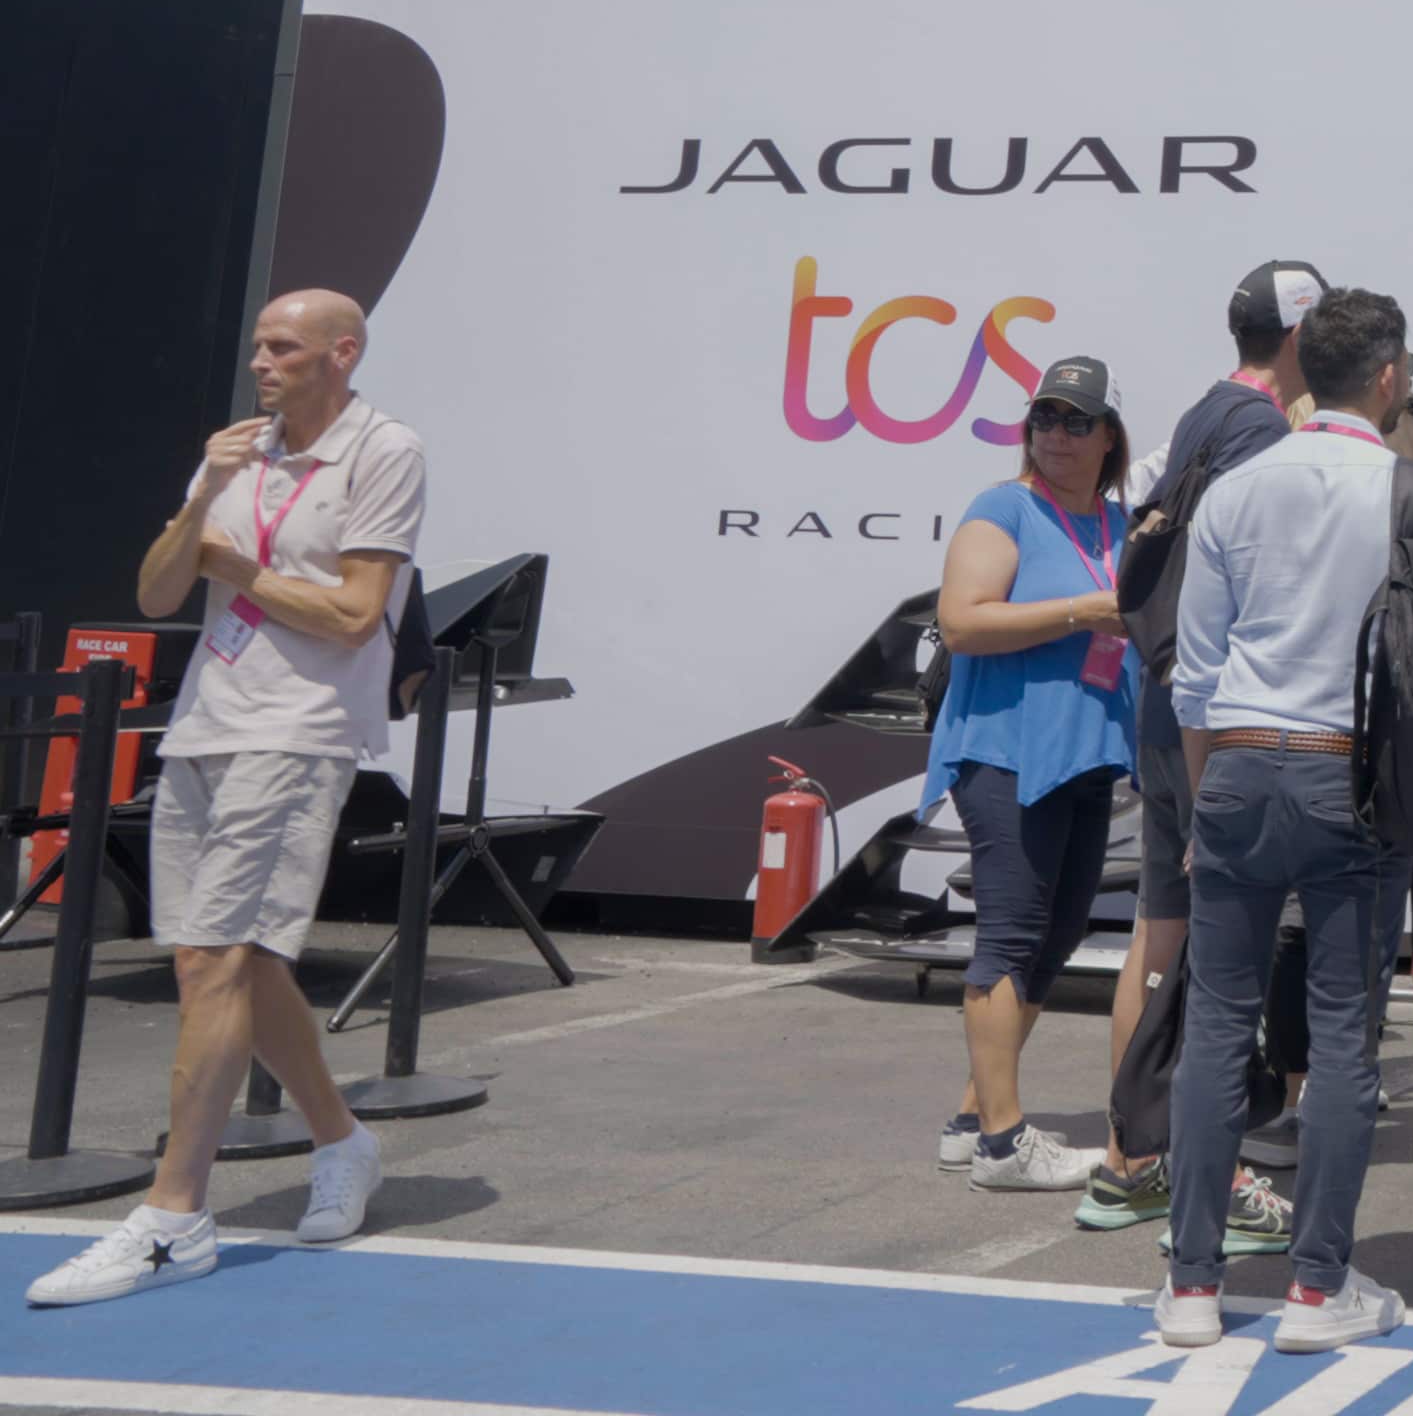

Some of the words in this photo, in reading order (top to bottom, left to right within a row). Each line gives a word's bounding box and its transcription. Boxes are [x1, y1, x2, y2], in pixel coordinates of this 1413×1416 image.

[618, 136, 1258, 196] JAGUAR
[782, 255, 1057, 446] tcs
[76, 638, 102, 650] RACE
[104, 640, 128, 653] CAR
